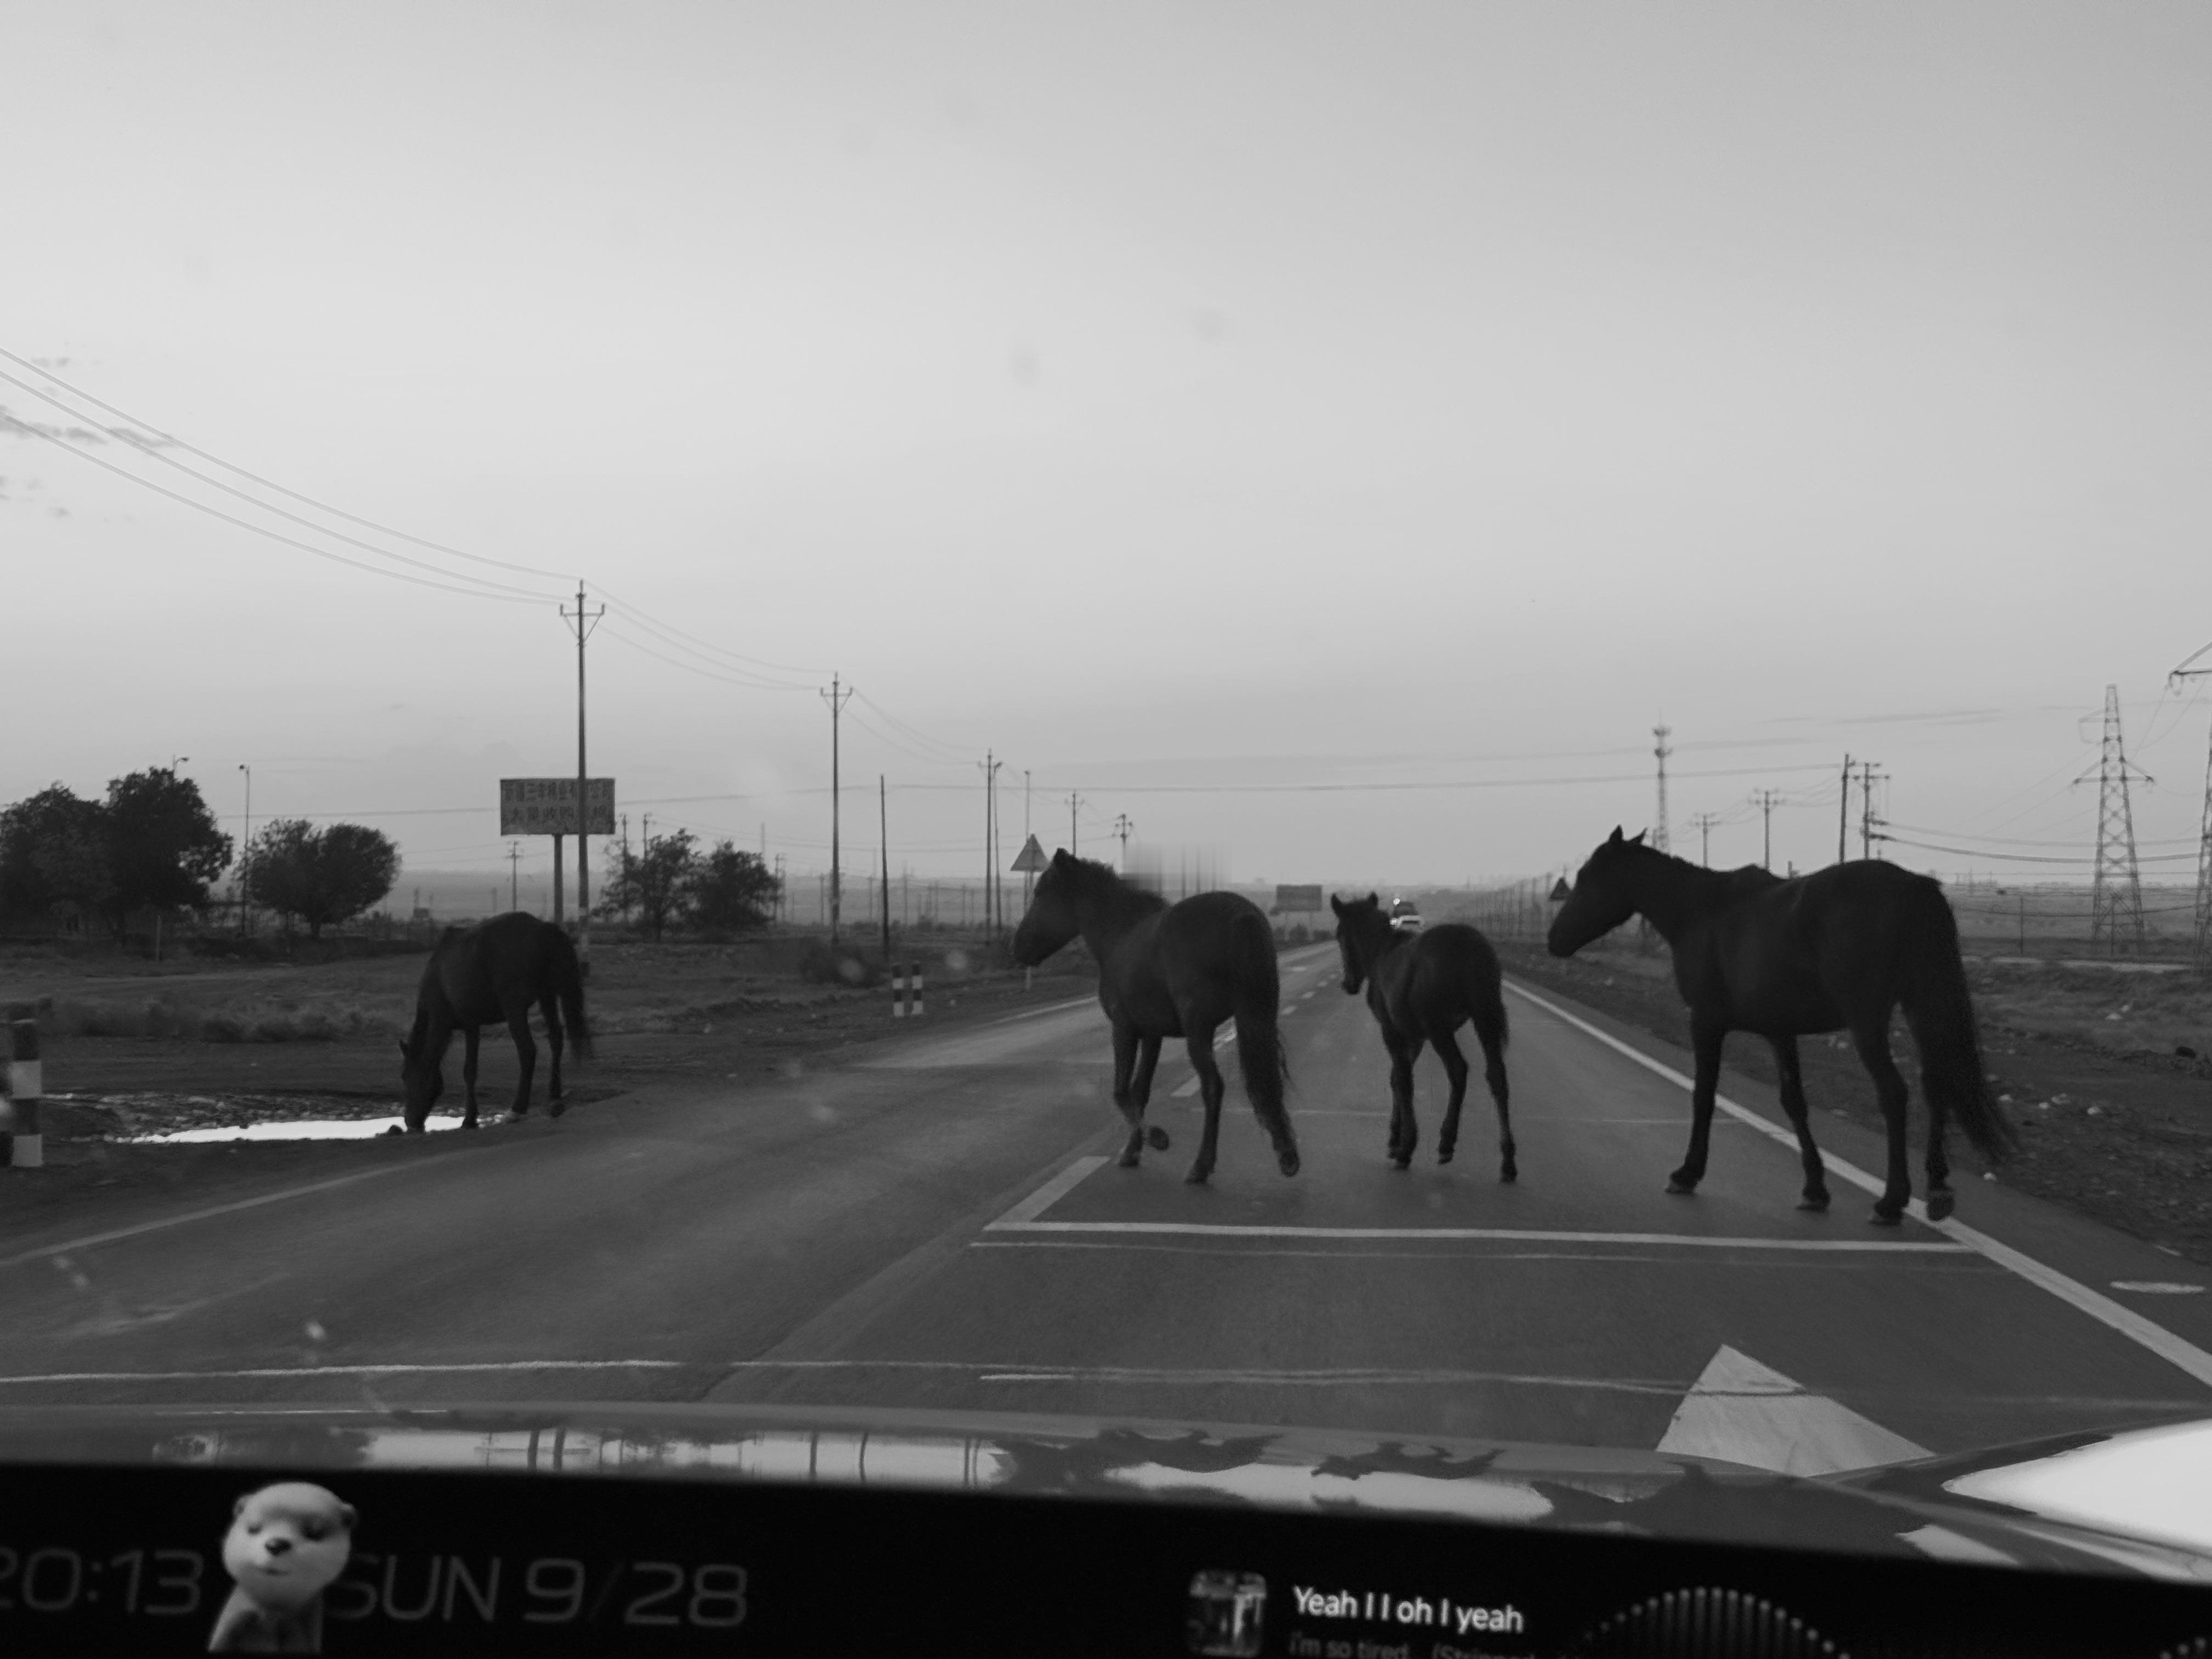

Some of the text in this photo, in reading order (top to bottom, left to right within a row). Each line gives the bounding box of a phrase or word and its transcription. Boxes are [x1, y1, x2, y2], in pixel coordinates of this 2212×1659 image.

[320, 1554, 502, 1622] SUN
[523, 1557, 748, 1627] 9/28
[1293, 1584, 1358, 1618] Yeah
[1396, 1596, 1434, 1625] oh
[1455, 1604, 1525, 1635] yeah
